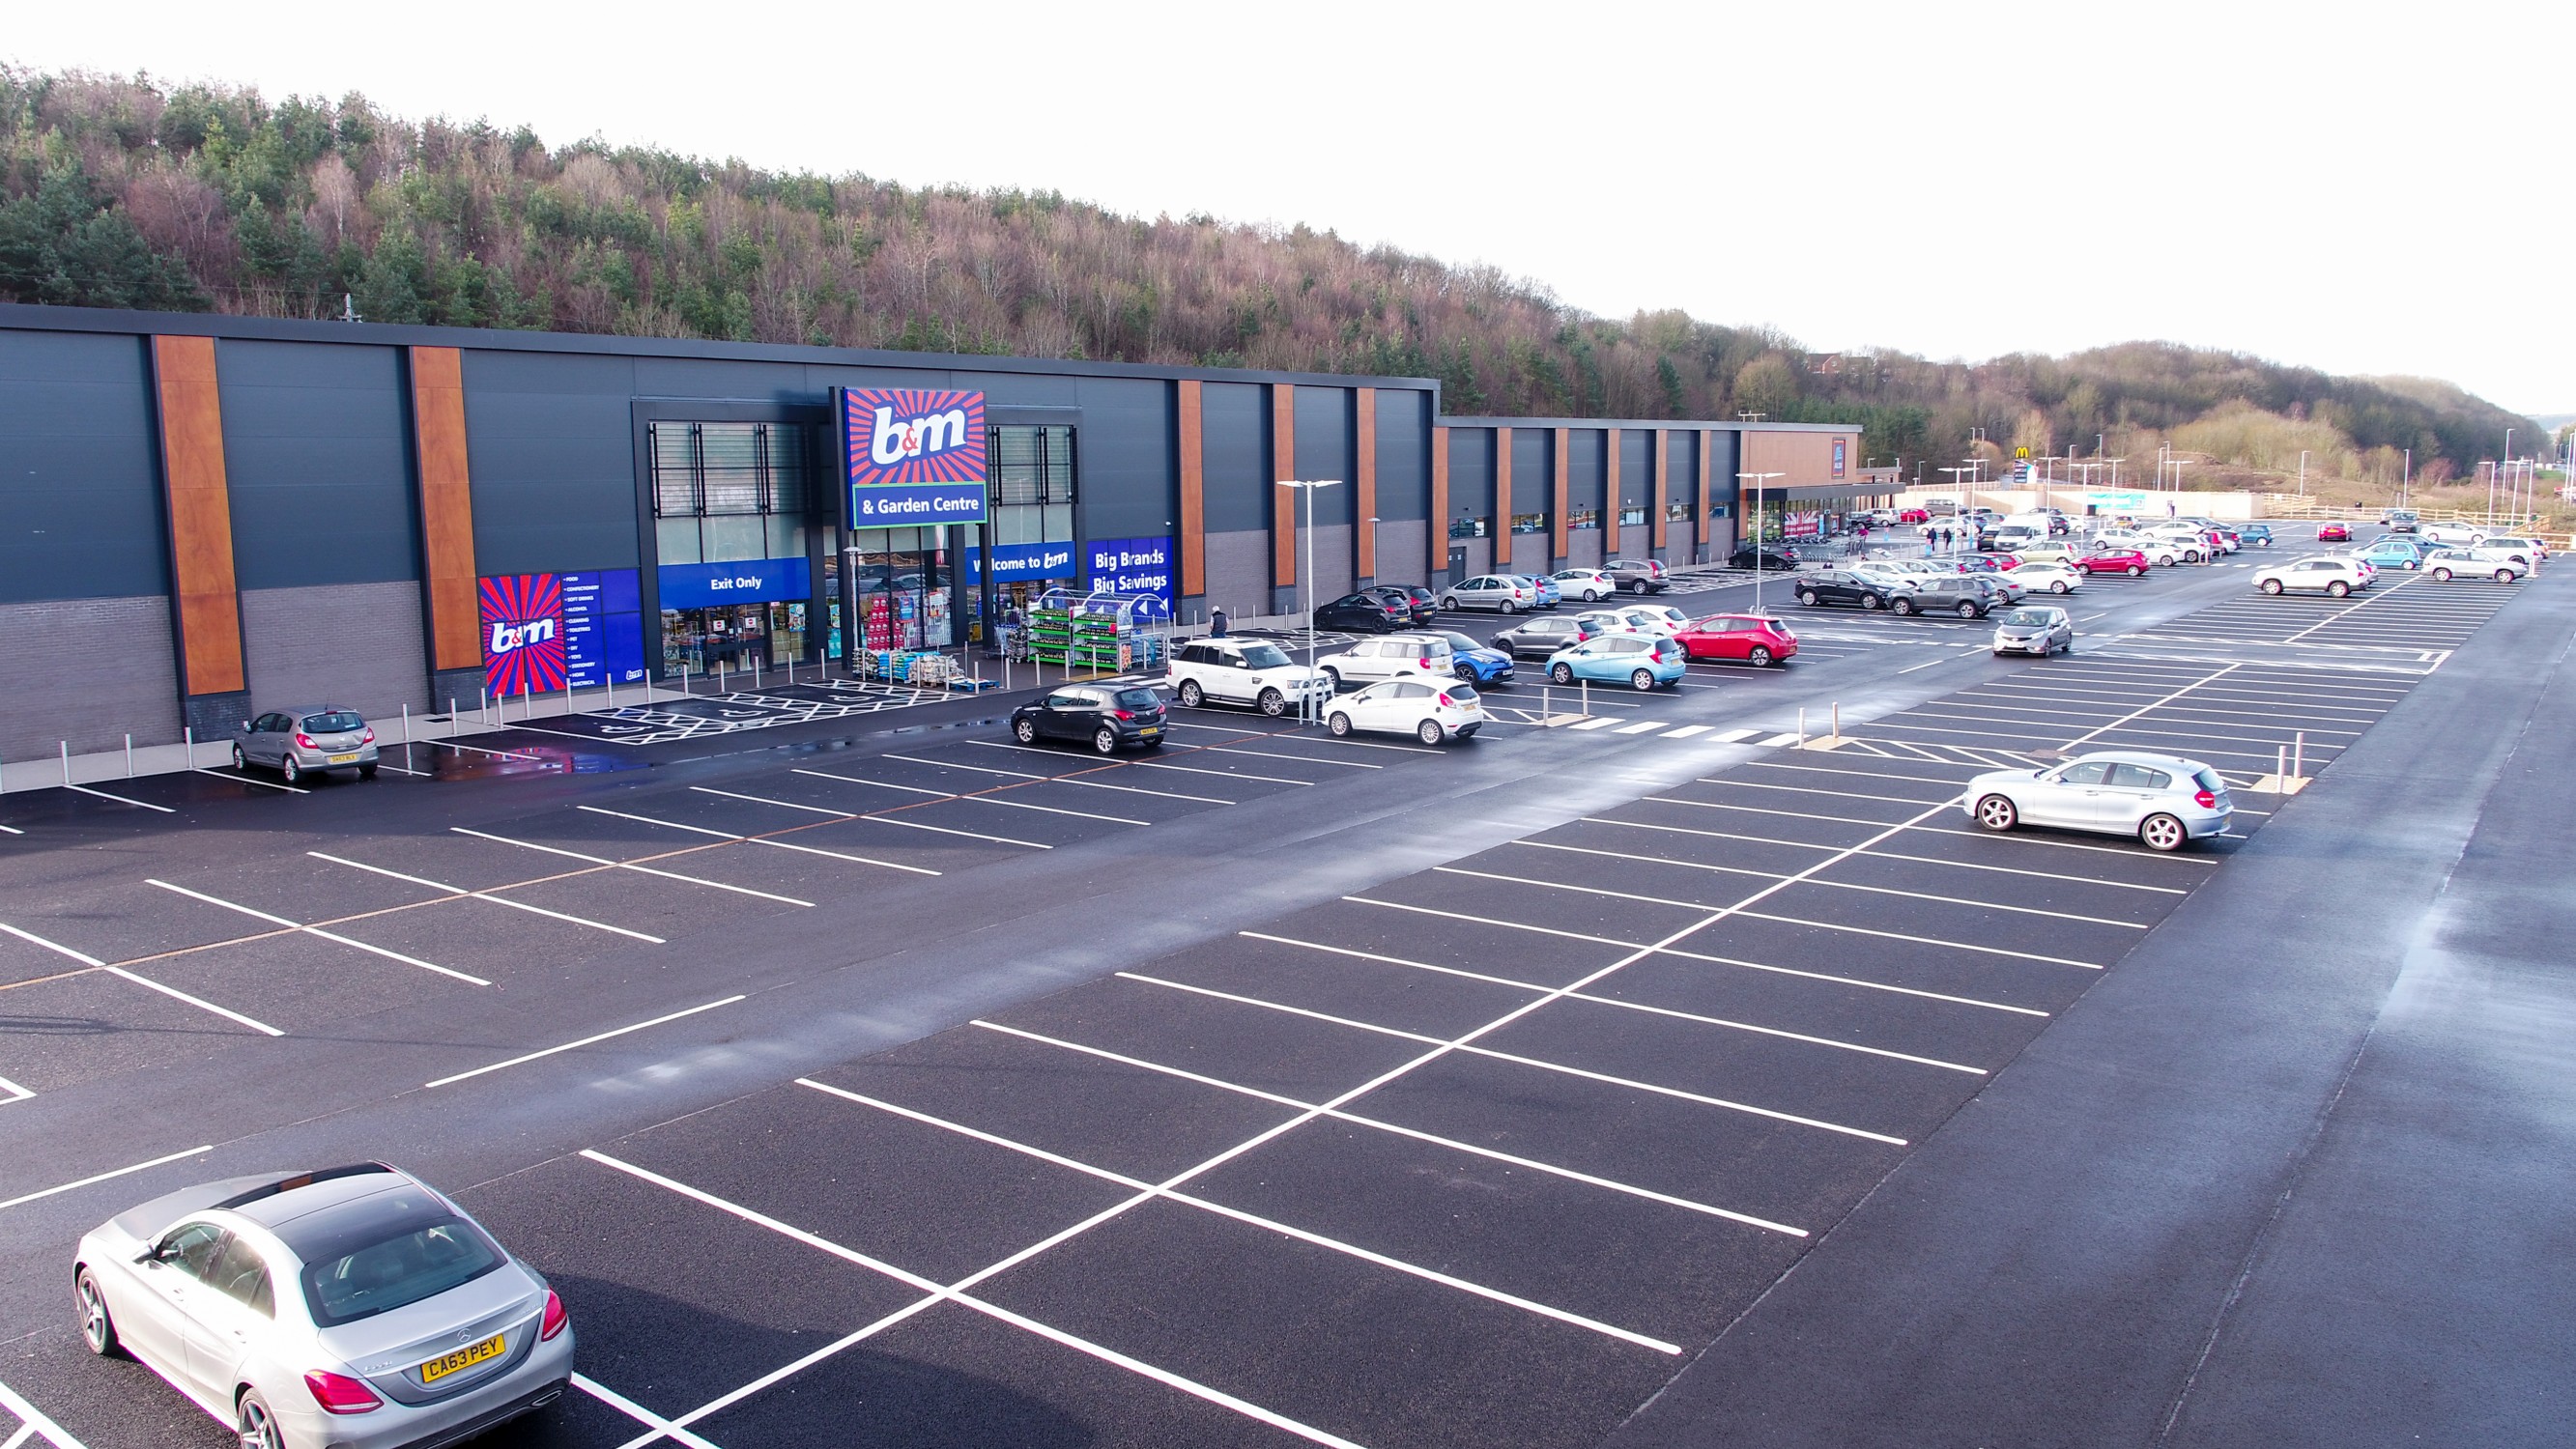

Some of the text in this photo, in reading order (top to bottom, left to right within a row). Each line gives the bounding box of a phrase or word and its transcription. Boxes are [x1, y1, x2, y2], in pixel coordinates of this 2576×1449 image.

[873, 407, 967, 465] b&m
[863, 497, 979, 514] & Garden Centre
[973, 557, 1025, 573] Wlcome
[1028, 556, 1041, 569] to
[1095, 549, 1164, 572] Big Brands
[711, 576, 762, 590] Exit Only
[1093, 573, 1167, 594] Big Savings
[491, 618, 556, 653] b&m
[428, 1338, 497, 1377] CA63 PEY
